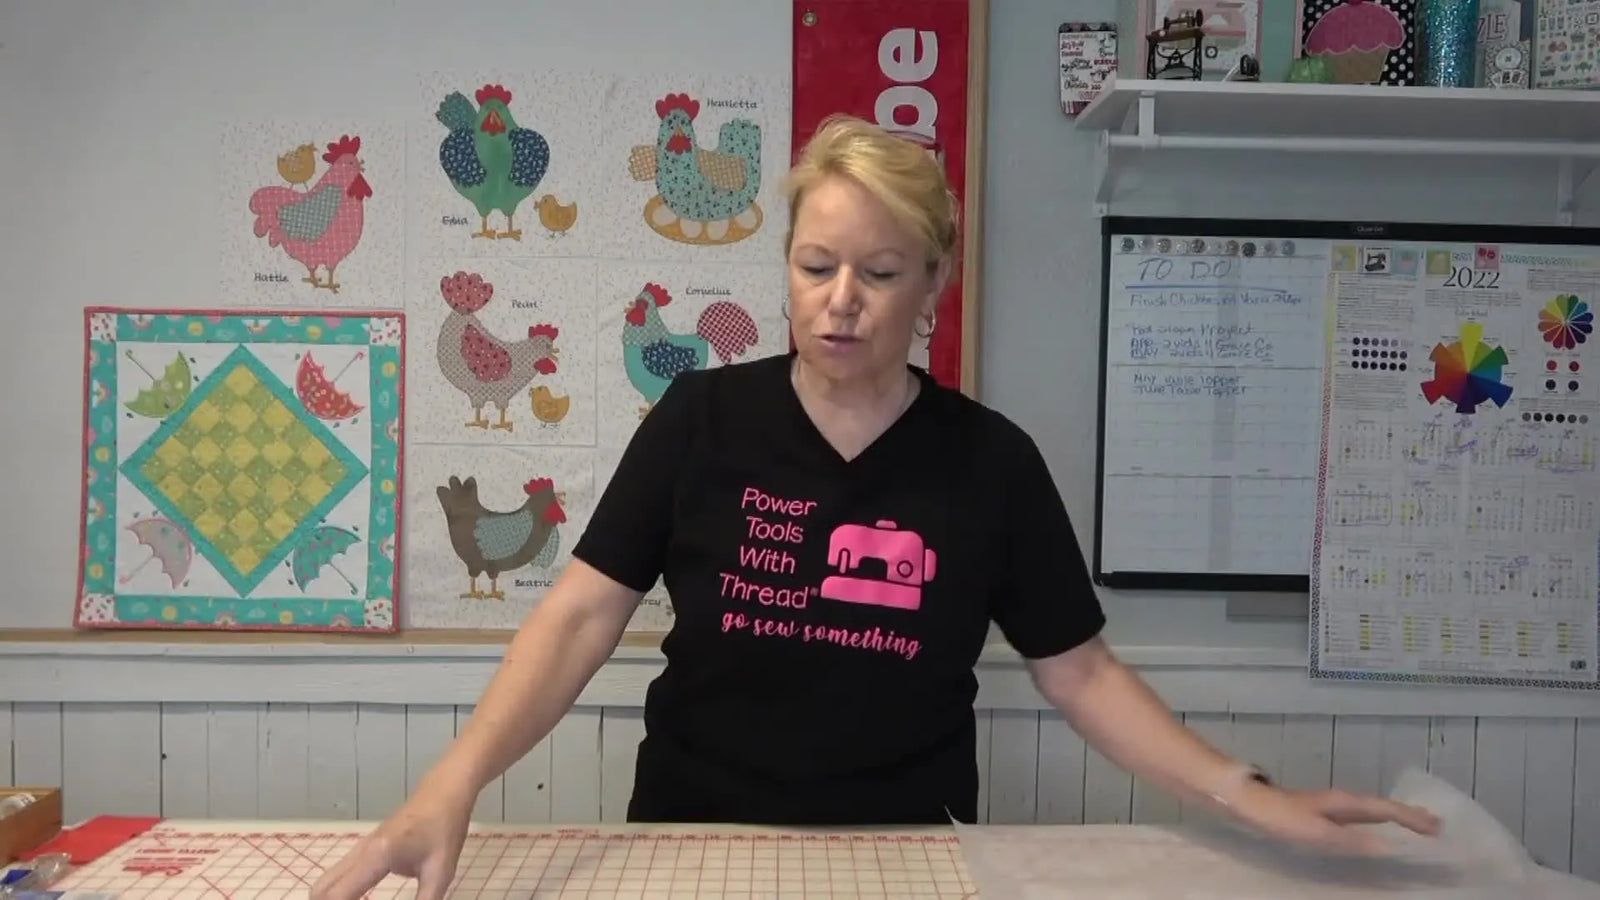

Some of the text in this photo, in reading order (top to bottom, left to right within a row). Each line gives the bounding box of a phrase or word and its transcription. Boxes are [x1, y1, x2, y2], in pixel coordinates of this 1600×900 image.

[1138, 257, 1232, 281] TO DO
[1442, 266, 1500, 289] 2022
[741, 487, 818, 516] Power
[746, 516, 804, 544] Tools
[739, 545, 796, 575] With
[719, 572, 809, 609] Thread
[722, 611, 923, 661] go sew something
